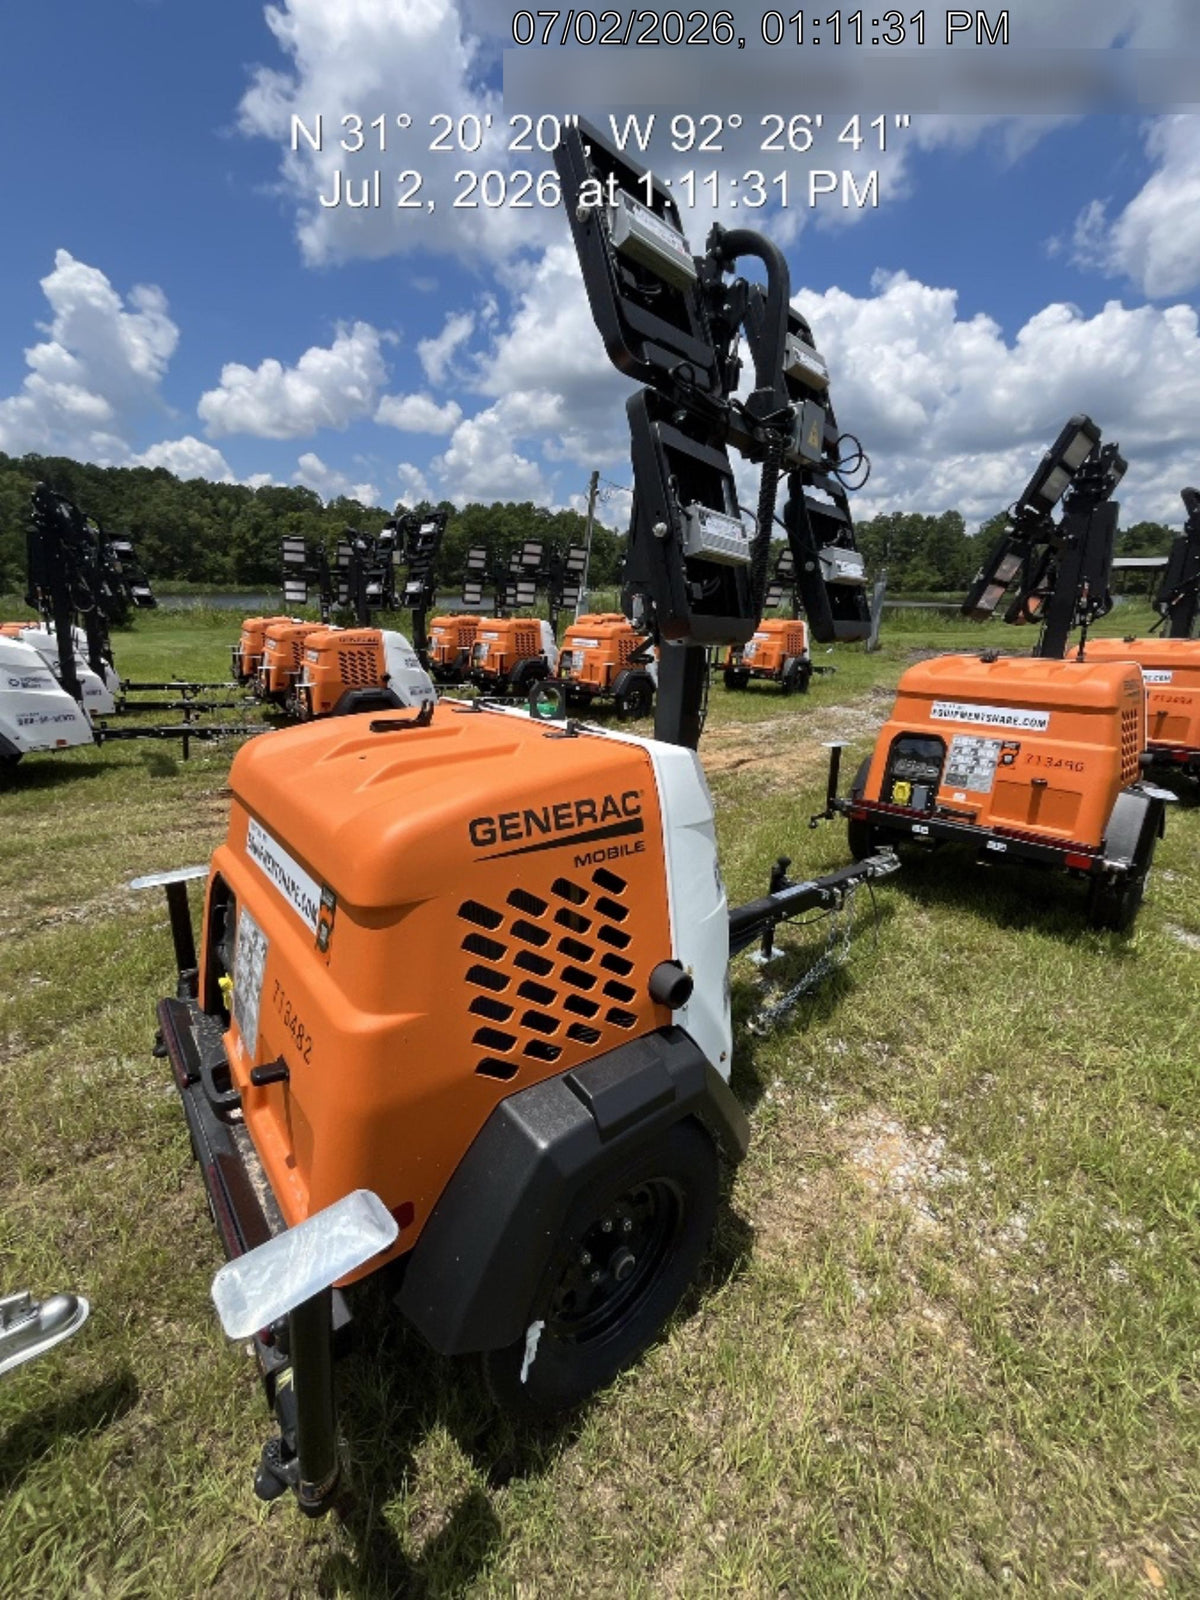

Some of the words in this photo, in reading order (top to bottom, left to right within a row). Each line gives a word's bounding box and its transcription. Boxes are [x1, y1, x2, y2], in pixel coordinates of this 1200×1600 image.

[469, 790, 643, 847] GENERAC
[574, 840, 646, 868] MOBILE
[273, 978, 313, 1066] 713482
